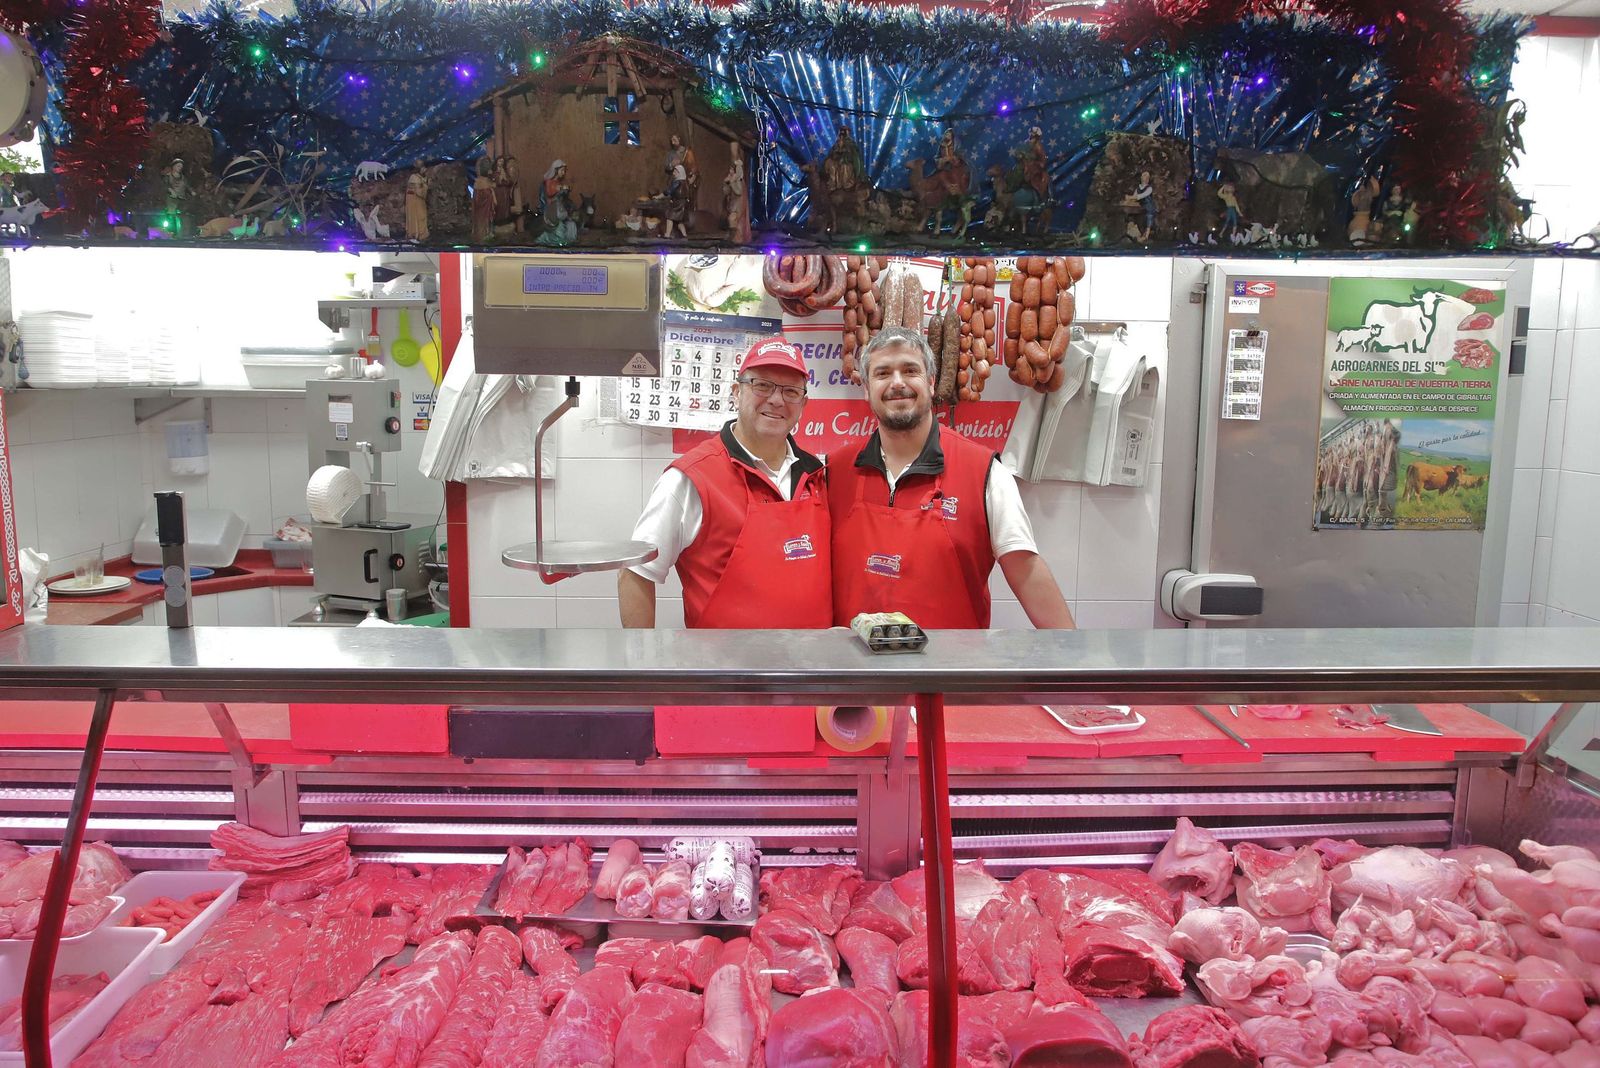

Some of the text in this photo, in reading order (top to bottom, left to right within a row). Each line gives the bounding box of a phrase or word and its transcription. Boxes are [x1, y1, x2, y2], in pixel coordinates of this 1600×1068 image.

[670, 332, 734, 346] Diciembre
[674, 349, 742, 365] 3 4 5 6
[672, 364, 682, 376] 10
[693, 366, 701, 378] 11
[713, 368, 722, 379] 12
[1330, 360, 1399, 372] AGROCARNES
[1402, 361, 1422, 373] DEL
[632, 378, 721, 395] 15 16 17 18 19
[1362, 380, 1402, 388] NATURAL
[1405, 380, 1417, 388] DE
[1419, 380, 1459, 388] NUESTRA
[1461, 380, 1491, 389] TIERRA
[630, 393, 641, 404] 22
[650, 395, 661, 406] 23
[669, 396, 681, 407] 24
[689, 398, 701, 409] 25
[709, 400, 721, 411] 26
[1329, 392, 1353, 400] CRIADA
[1422, 393, 1445, 401] CAMPO
[629, 408, 679, 423] 29 30 31
[1448, 405, 1479, 413] DESPIECE
[805, 420, 824, 436] en
[832, 411, 879, 437] Cali
